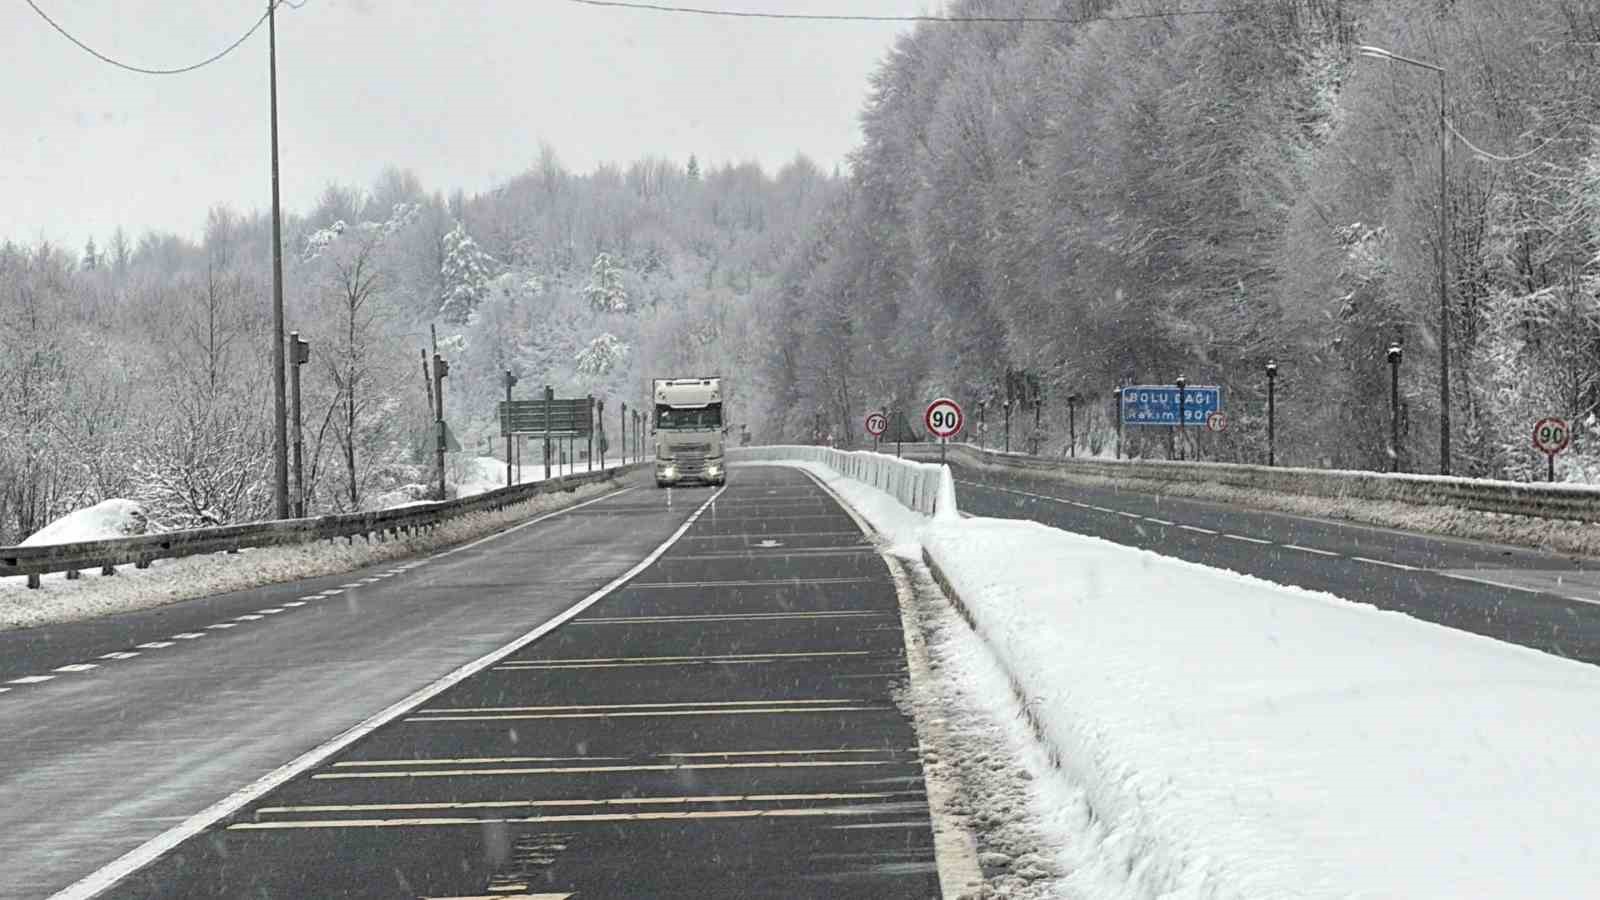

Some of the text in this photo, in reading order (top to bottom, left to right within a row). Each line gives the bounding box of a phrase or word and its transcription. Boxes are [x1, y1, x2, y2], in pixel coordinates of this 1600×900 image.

[1130, 392, 1169, 403] BOLU
[870, 418, 885, 430] 70
[932, 410, 956, 429] 90
[1211, 416, 1225, 428] 70
[1540, 426, 1563, 444] 90
